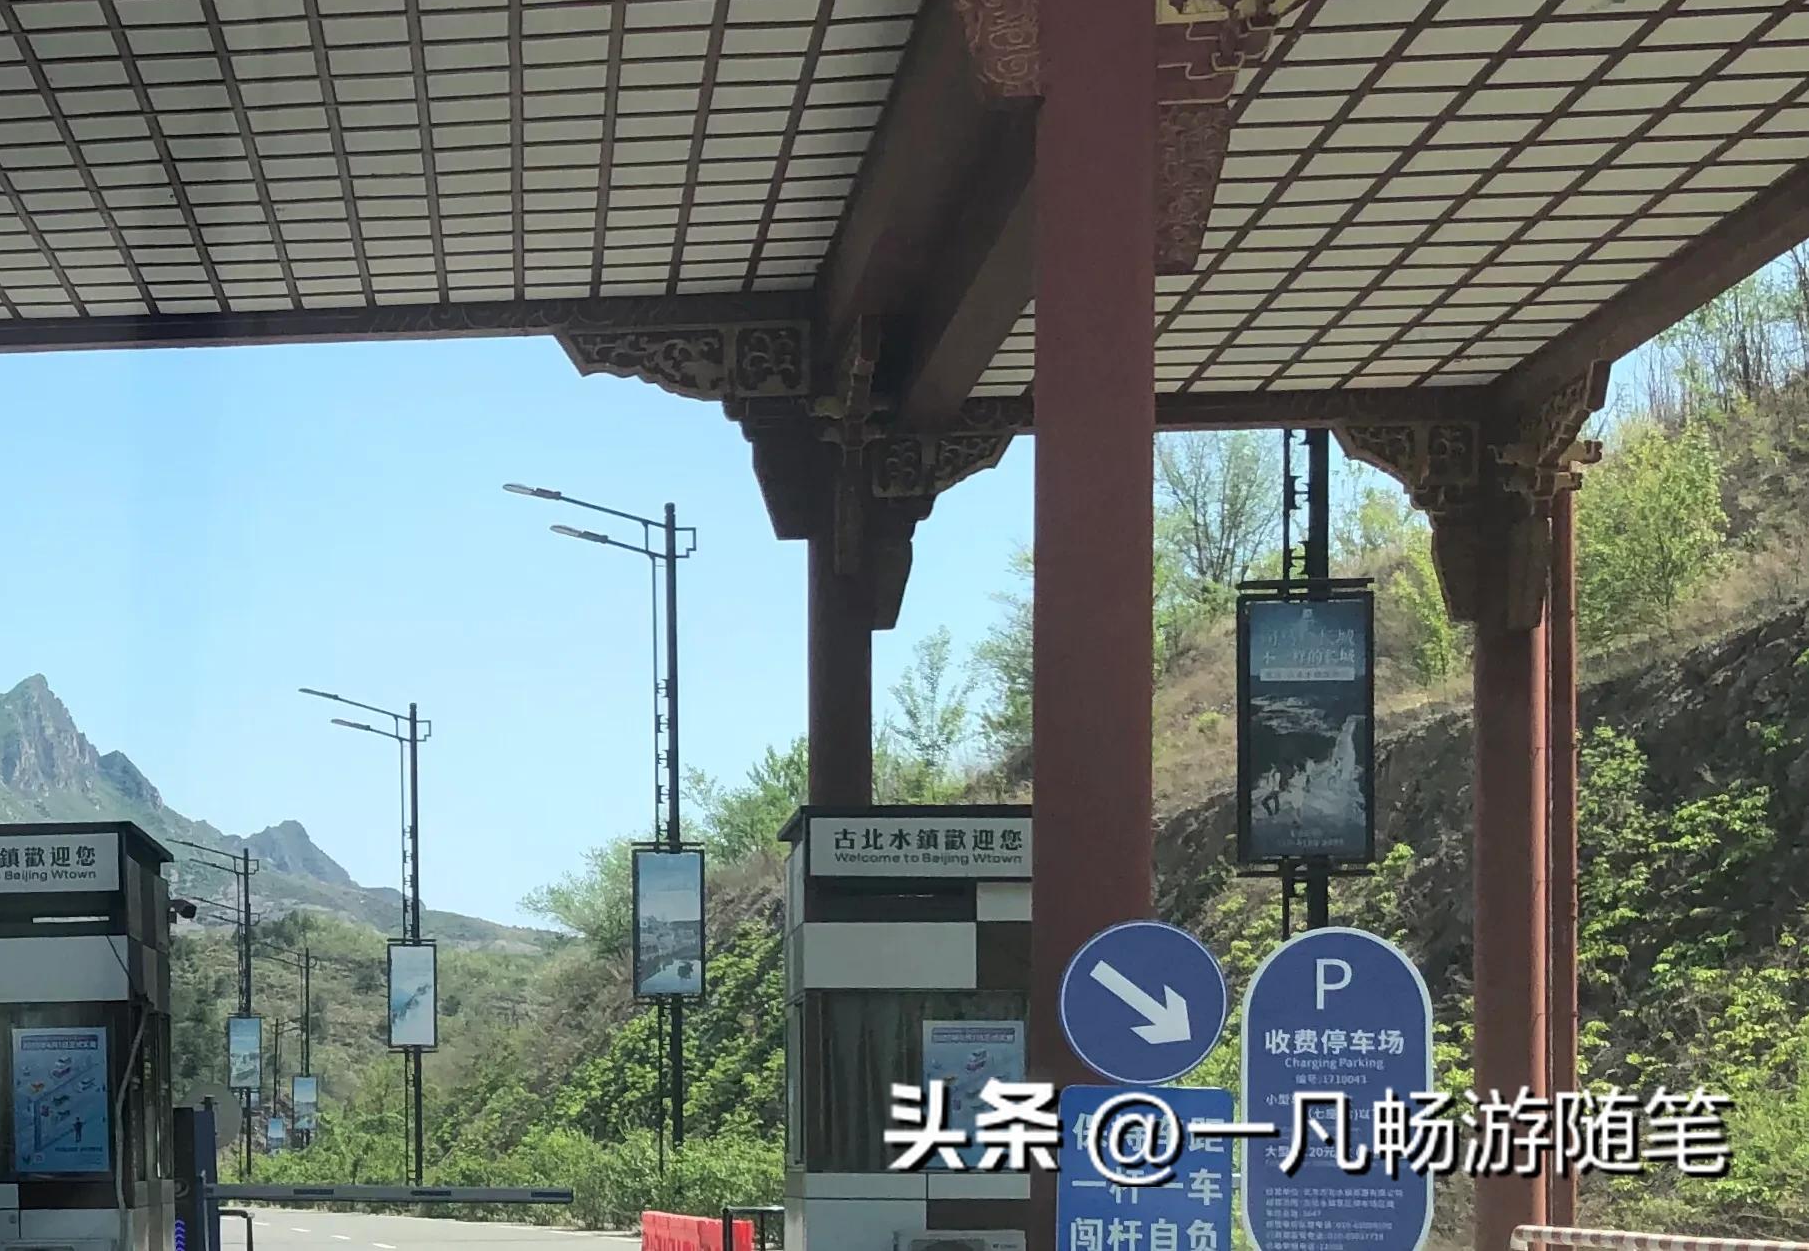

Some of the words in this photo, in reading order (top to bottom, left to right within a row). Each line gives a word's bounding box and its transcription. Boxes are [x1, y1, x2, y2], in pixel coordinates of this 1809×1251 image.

[834, 828, 1023, 850] 古北水鎮歡迎您
[834, 852, 900, 863] Welcome
[904, 852, 920, 863] to
[922, 852, 969, 865] Beijing
[972, 852, 1023, 864] Wtown
[4, 870, 48, 882] Beijing
[51, 869, 97, 879] Wtown
[1316, 958, 1353, 1010] P
[1264, 1029, 1405, 1055] 收费停车场
[1284, 1057, 1337, 1070] Charging
[1339, 1057, 1384, 1070] Parking
